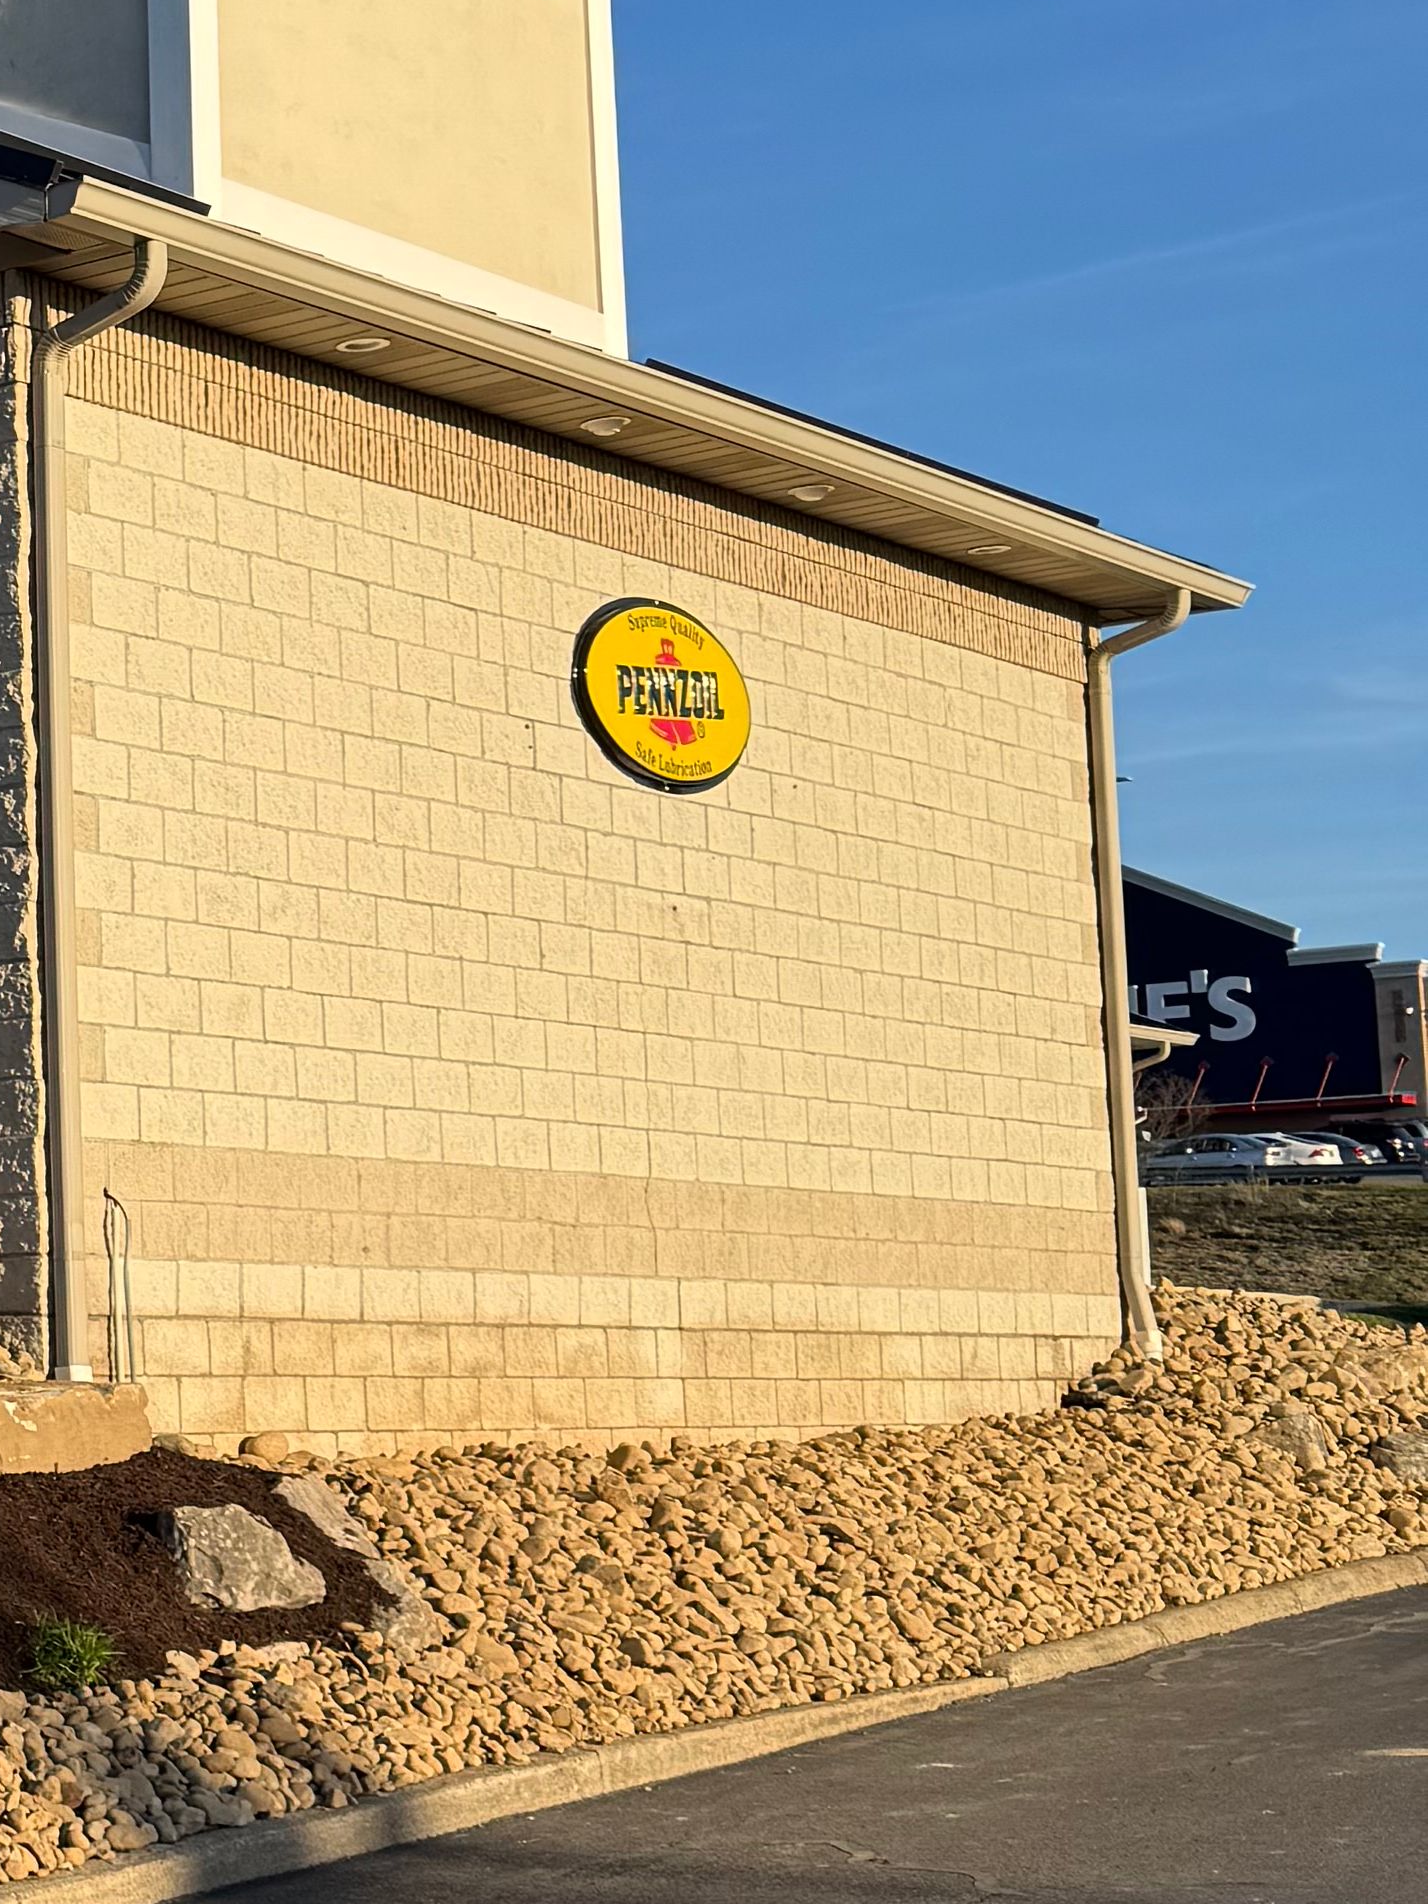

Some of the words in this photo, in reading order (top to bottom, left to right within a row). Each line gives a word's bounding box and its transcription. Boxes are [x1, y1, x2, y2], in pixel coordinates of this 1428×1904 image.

[669, 614, 706, 651] Quality
[615, 663, 725, 721] PENNZOIL
[634, 740, 657, 768] Safe
[658, 753, 713, 778] Lubrication
[1128, 968, 1257, 1042] E'S
